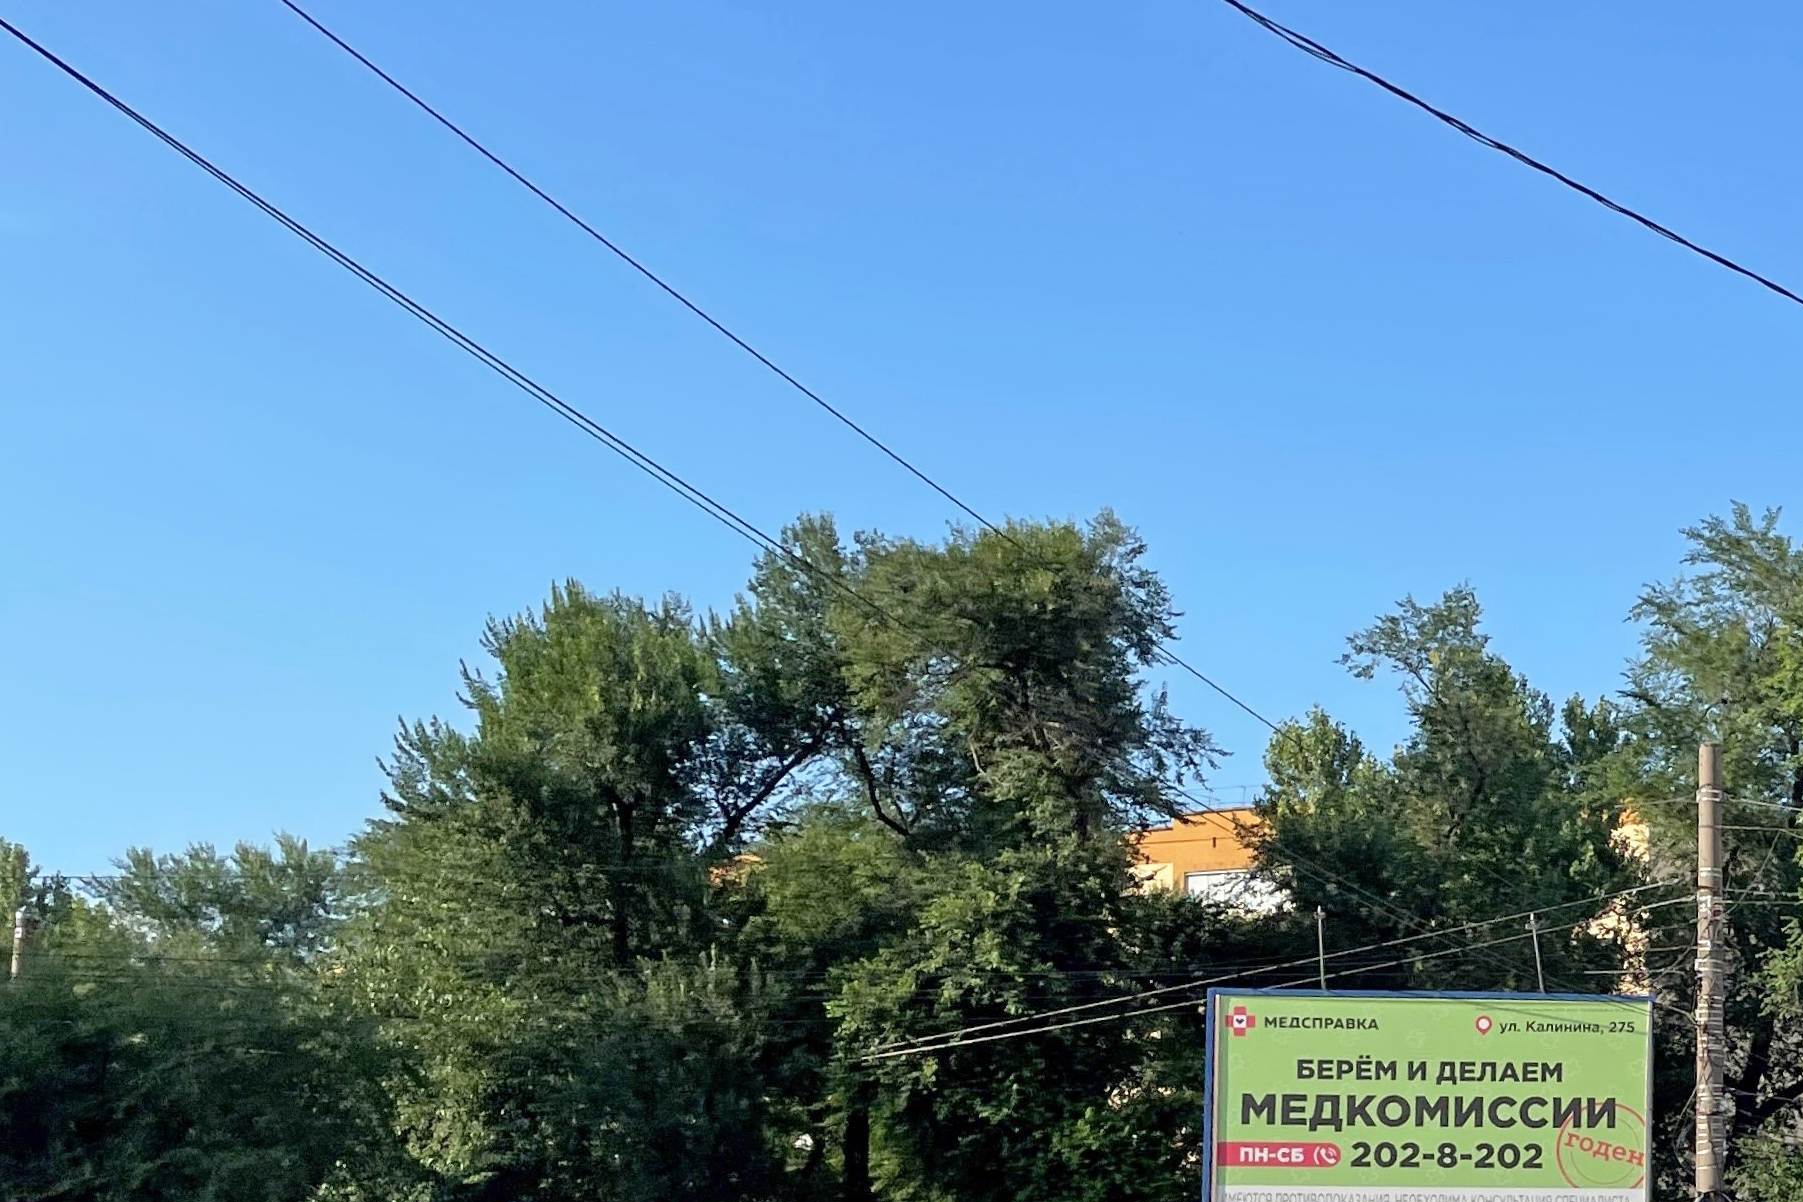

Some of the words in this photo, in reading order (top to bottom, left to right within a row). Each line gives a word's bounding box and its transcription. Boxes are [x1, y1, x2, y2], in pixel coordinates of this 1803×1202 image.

[1264, 1016, 1379, 1030] МЕДСПРАВКА
[1499, 1022, 1521, 1034] ул.
[1526, 1021, 1604, 1035] Калинина,
[1608, 1021, 1635, 1033] 275
[1297, 1055, 1397, 1081] БЕРЁМ
[1407, 1060, 1427, 1081] И
[1436, 1061, 1563, 1085] ДЕЛАЕМ
[1241, 1093, 1616, 1132] МЕДКОМИССИИ
[1239, 1146, 1305, 1163] ПН-СБ
[1350, 1141, 1544, 1169] 202-8-202
[1564, 1132, 1645, 1167] годен
